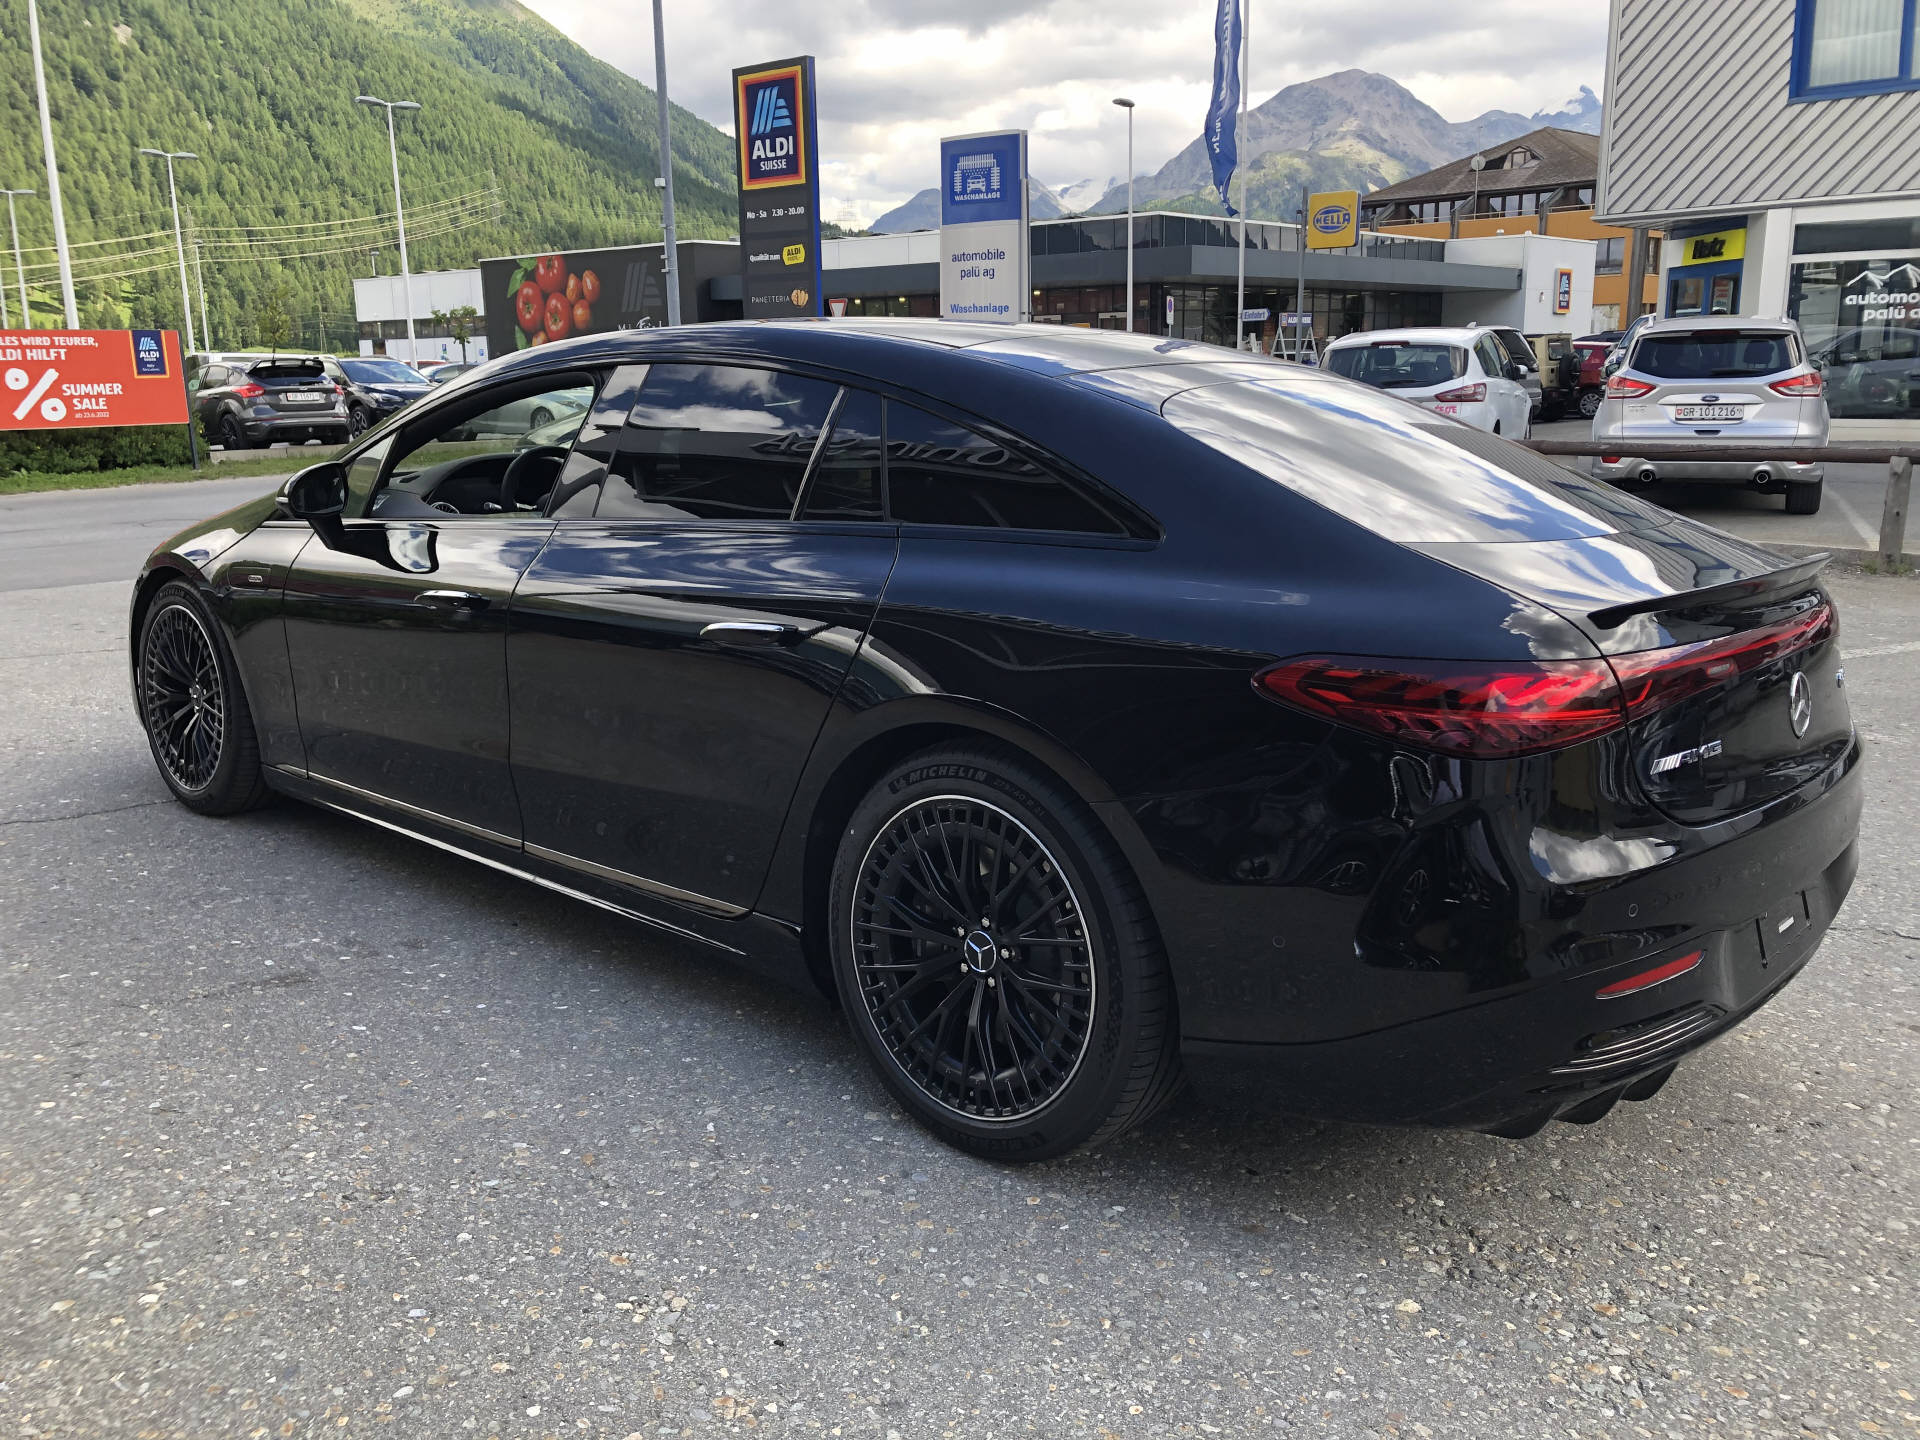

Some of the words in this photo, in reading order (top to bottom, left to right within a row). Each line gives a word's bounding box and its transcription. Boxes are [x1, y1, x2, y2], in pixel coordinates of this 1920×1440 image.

[752, 136, 794, 160] ALDI
[760, 159, 787, 171] SUISSE
[954, 191, 1001, 201] WASCHANLAGE
[759, 209, 767, 218] Sa
[771, 208, 784, 217] 7.30
[788, 206, 805, 216] 20.00
[1315, 212, 1351, 225] HELLA
[787, 247, 801, 257] ALDI
[951, 249, 1005, 263] automobile
[960, 266, 980, 280] palü
[982, 268, 995, 280] ag
[1845, 291, 1920, 305] automo
[950, 302, 1010, 315] Waschanlage
[1863, 305, 1906, 322] palü
[21, 336, 50, 346] WIRD
[53, 336, 99, 348] TEURER,
[27, 348, 67, 361] HILFT
[139, 351, 160, 359] ALDI
[62, 383, 123, 396] SUMMER
[73, 397, 108, 410] SALE
[909, 765, 988, 784] MICHELIN
